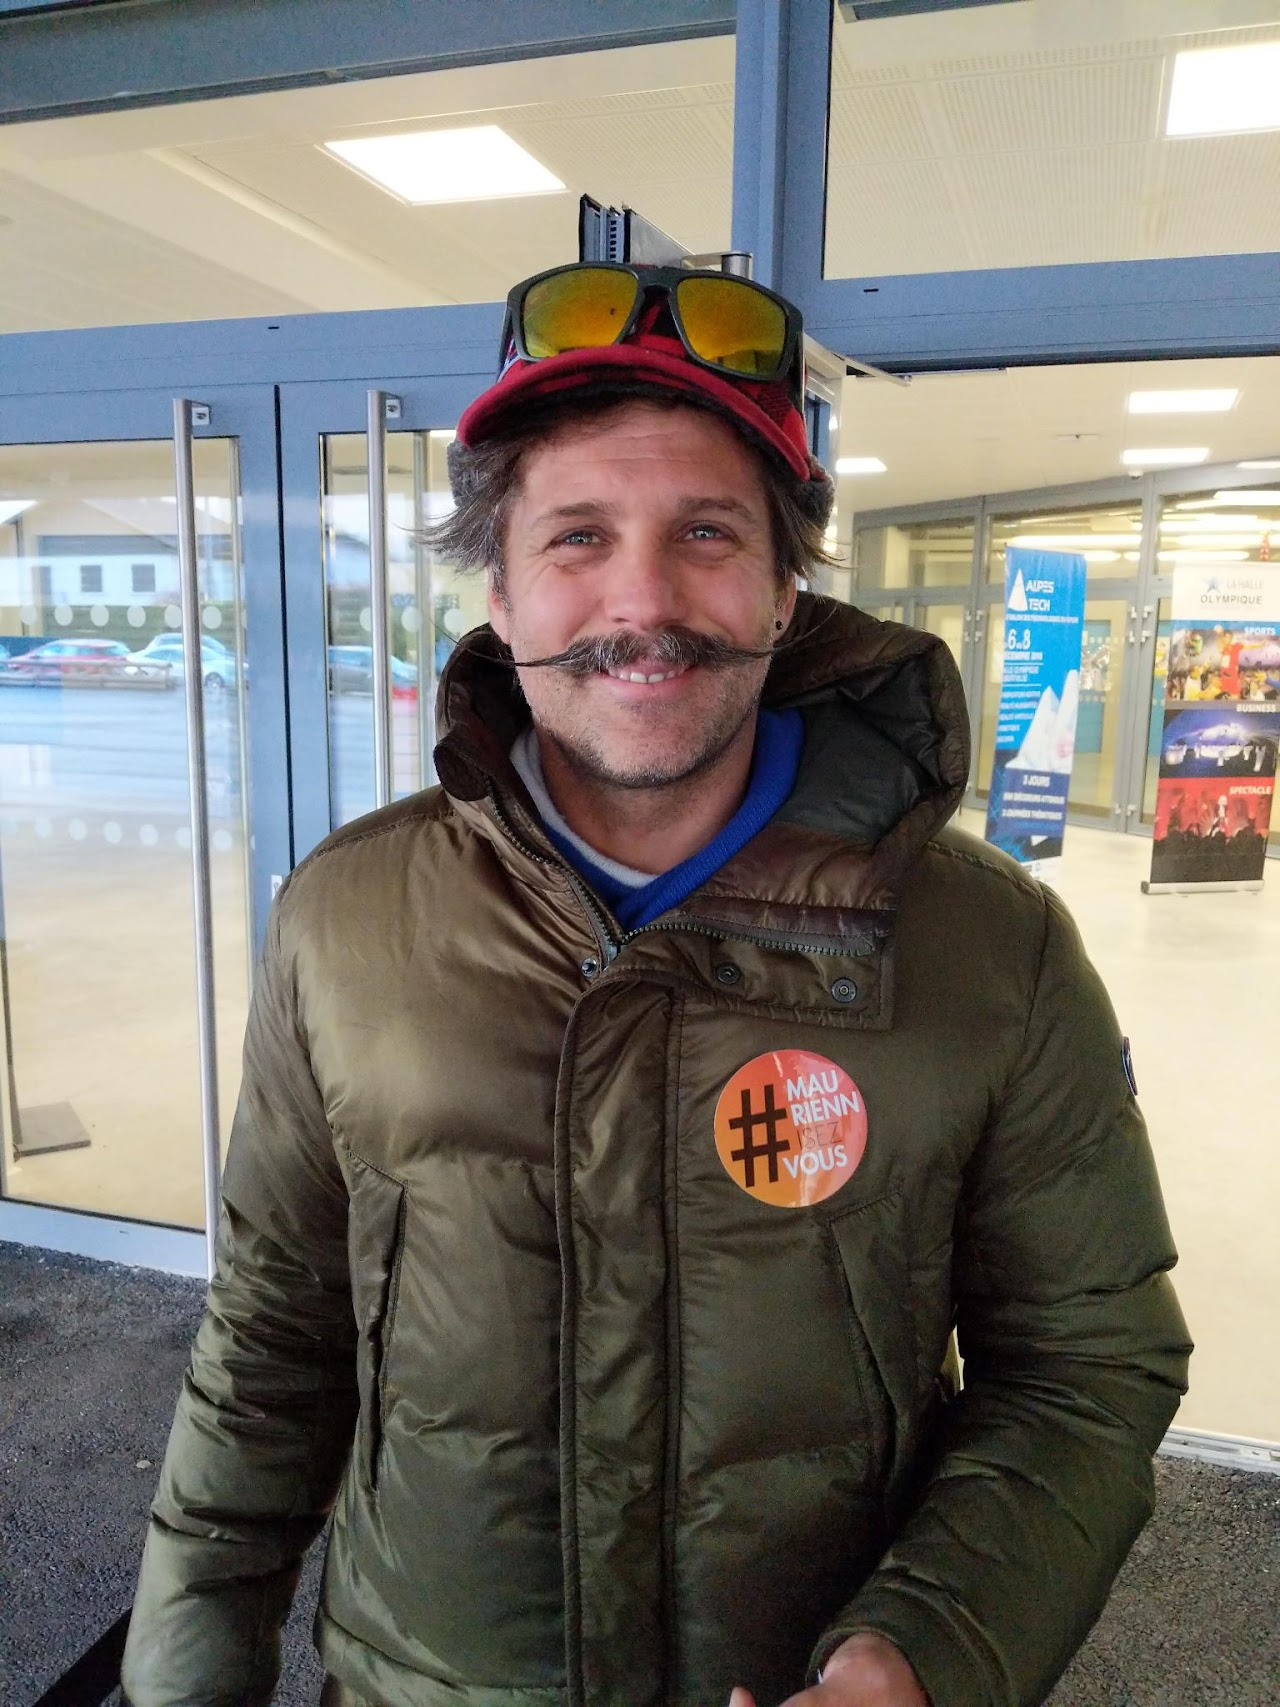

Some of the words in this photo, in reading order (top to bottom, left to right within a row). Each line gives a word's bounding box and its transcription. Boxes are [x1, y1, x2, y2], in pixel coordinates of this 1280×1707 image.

[1026, 579, 1055, 593] ALPES
[1028, 598, 1051, 612] TECH
[1200, 594, 1263, 605] OLYMPIQUE
[1243, 627, 1276, 636] SPORTS
[1008, 628, 1017, 650] 6
[1023, 628, 1031, 650] 8
[1236, 703, 1276, 713] BUSINESS
[1229, 785, 1272, 795] SPECTACLE
[786, 1069, 838, 1102] MAU
[790, 1091, 860, 1127] RIENN
[782, 1144, 848, 1179] VOUS
